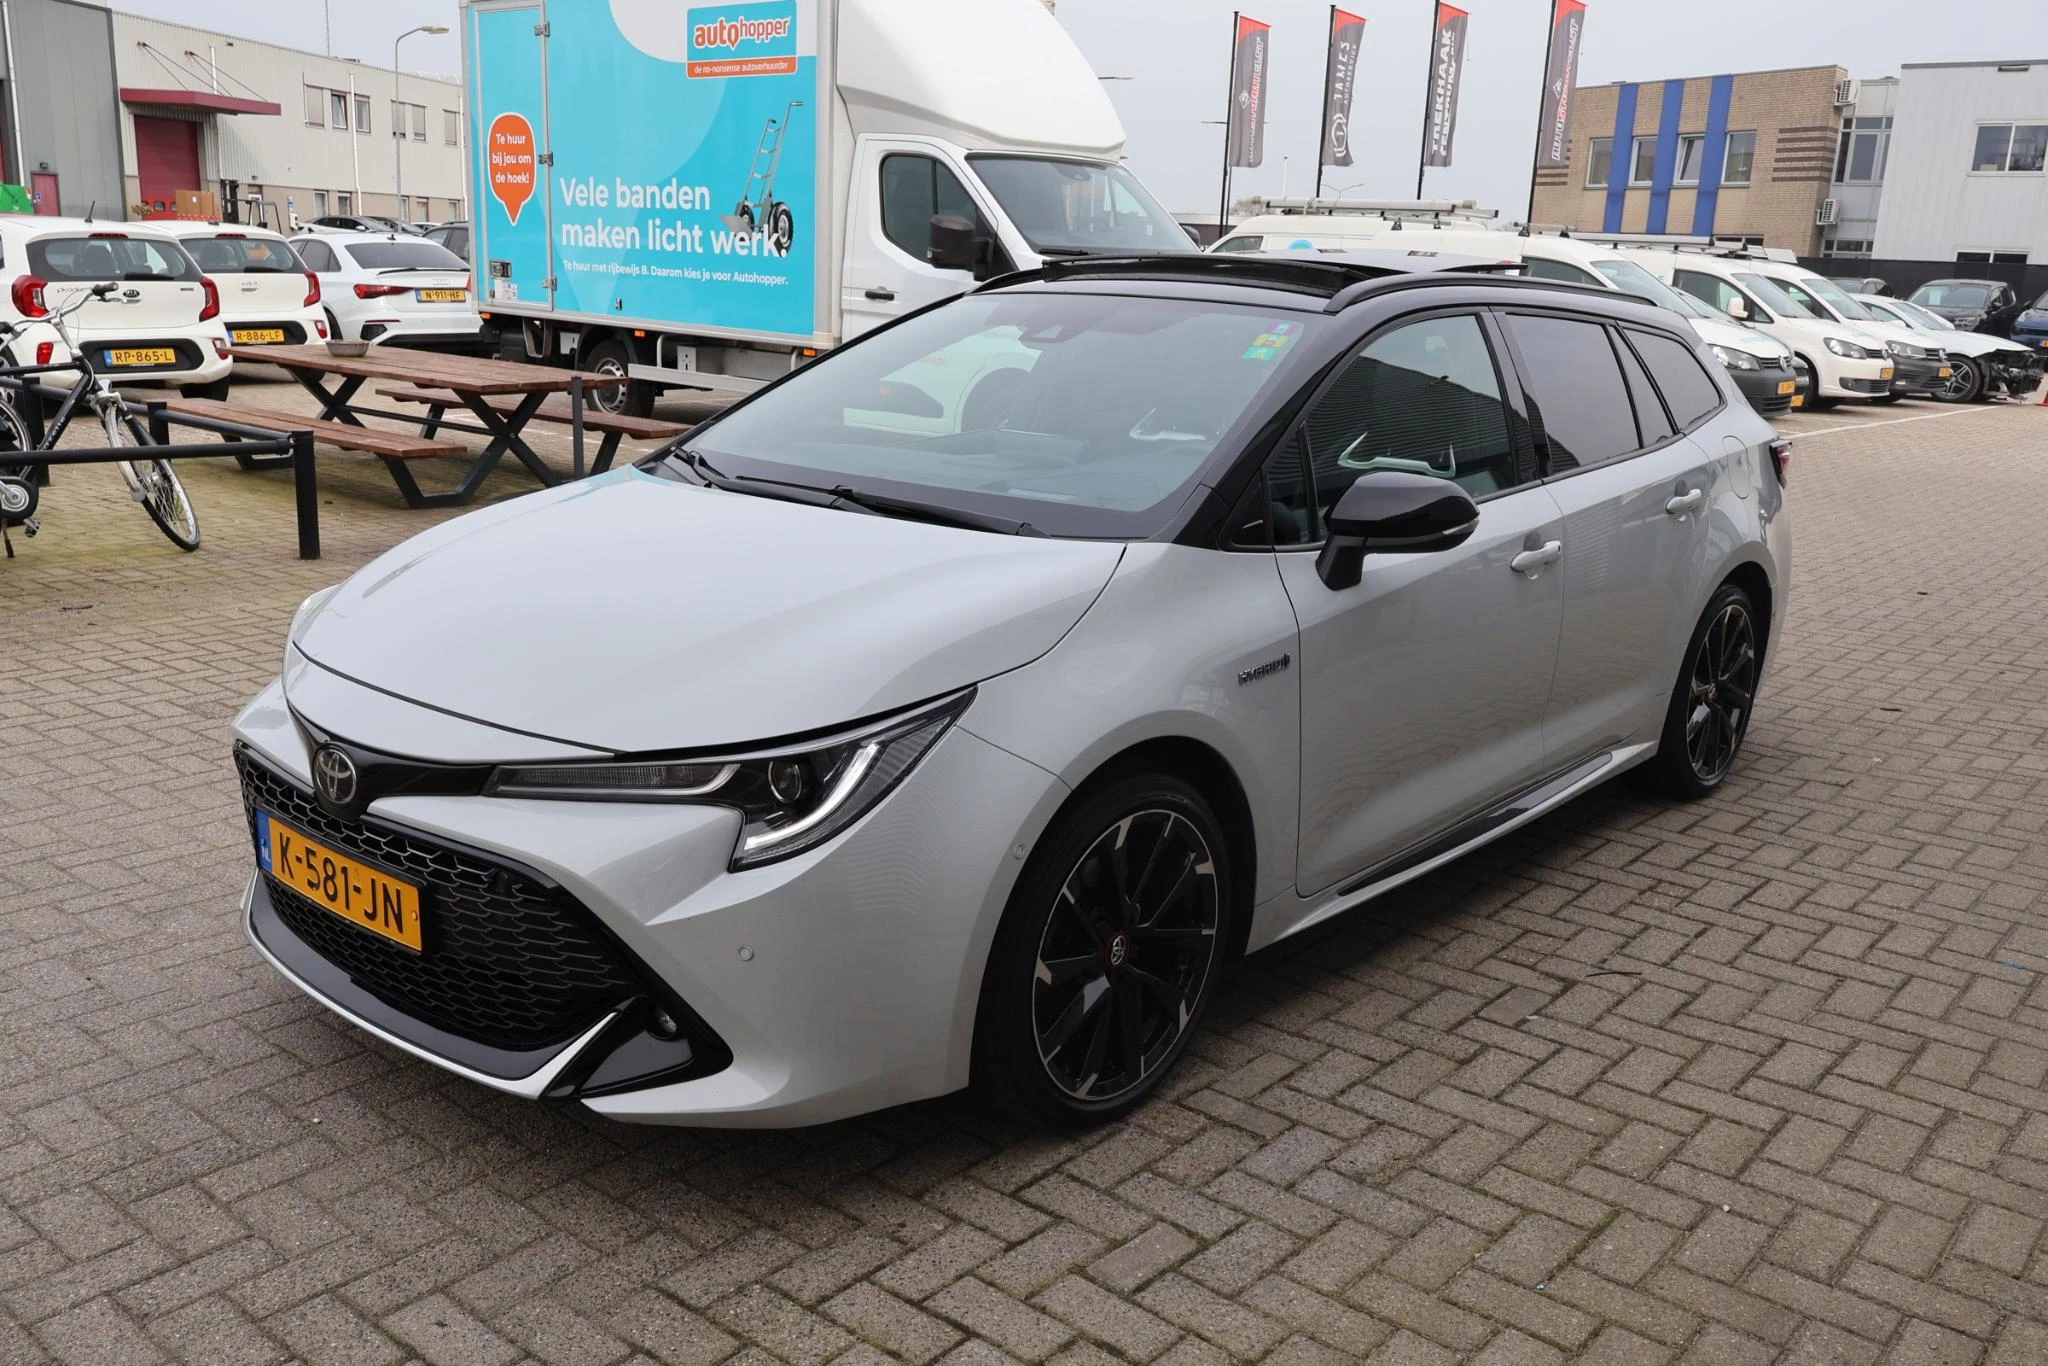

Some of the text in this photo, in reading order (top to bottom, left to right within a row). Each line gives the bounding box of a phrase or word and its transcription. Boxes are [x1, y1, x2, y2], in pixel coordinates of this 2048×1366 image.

[694, 17, 789, 50] autohopper
[694, 64, 702, 74] de
[1333, 41, 1349, 102] JAMES
[496, 133, 526, 144] Te huur
[492, 152, 532, 167] bij jou om
[495, 172, 530, 184] de hoek!
[560, 177, 711, 211] Vele banden
[561, 218, 788, 258] maken licht werk.
[563, 260, 789, 287] Te huur met rijbewijs B. Daarom kies je voor Autohopper.
[236, 331, 280, 341] R-886-LF
[115, 351, 172, 362] RP-865-L
[279, 832, 403, 934] K-581-JN
